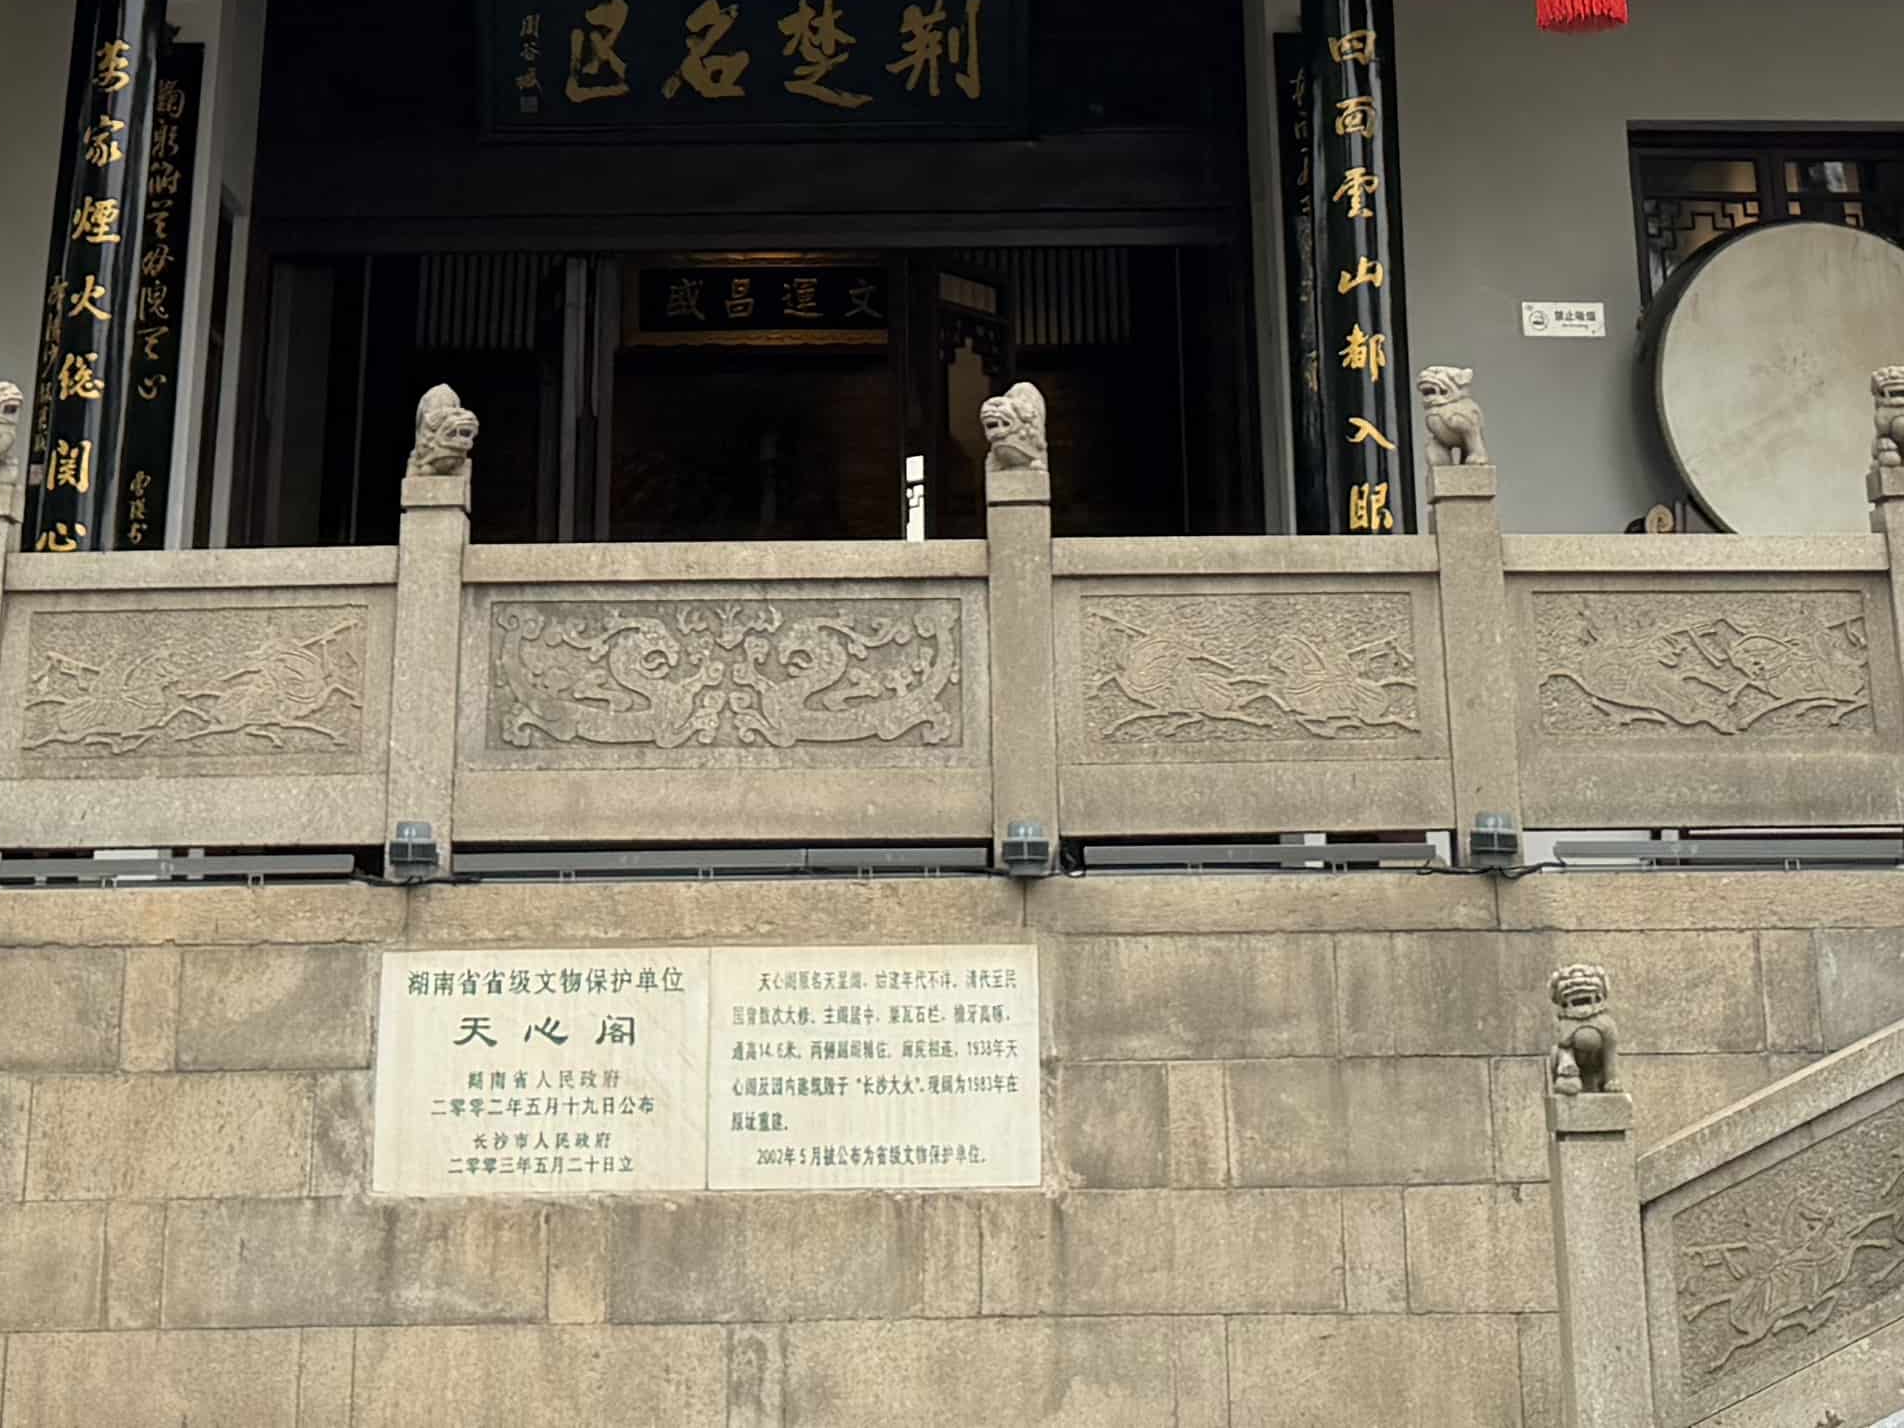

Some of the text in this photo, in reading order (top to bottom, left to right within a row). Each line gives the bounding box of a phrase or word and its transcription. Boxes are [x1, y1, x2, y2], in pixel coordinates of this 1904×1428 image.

[407, 966, 685, 996] 湖南省省级文物保护单位
[452, 1015, 636, 1047] 天心阁
[466, 1069, 622, 1090] 湖南省人民政府
[431, 1095, 656, 1117] 二零零二年五月十九日公布
[472, 1131, 612, 1150] 长沙市人民政府
[447, 1154, 635, 1175] 二零零三年五月二十日立
